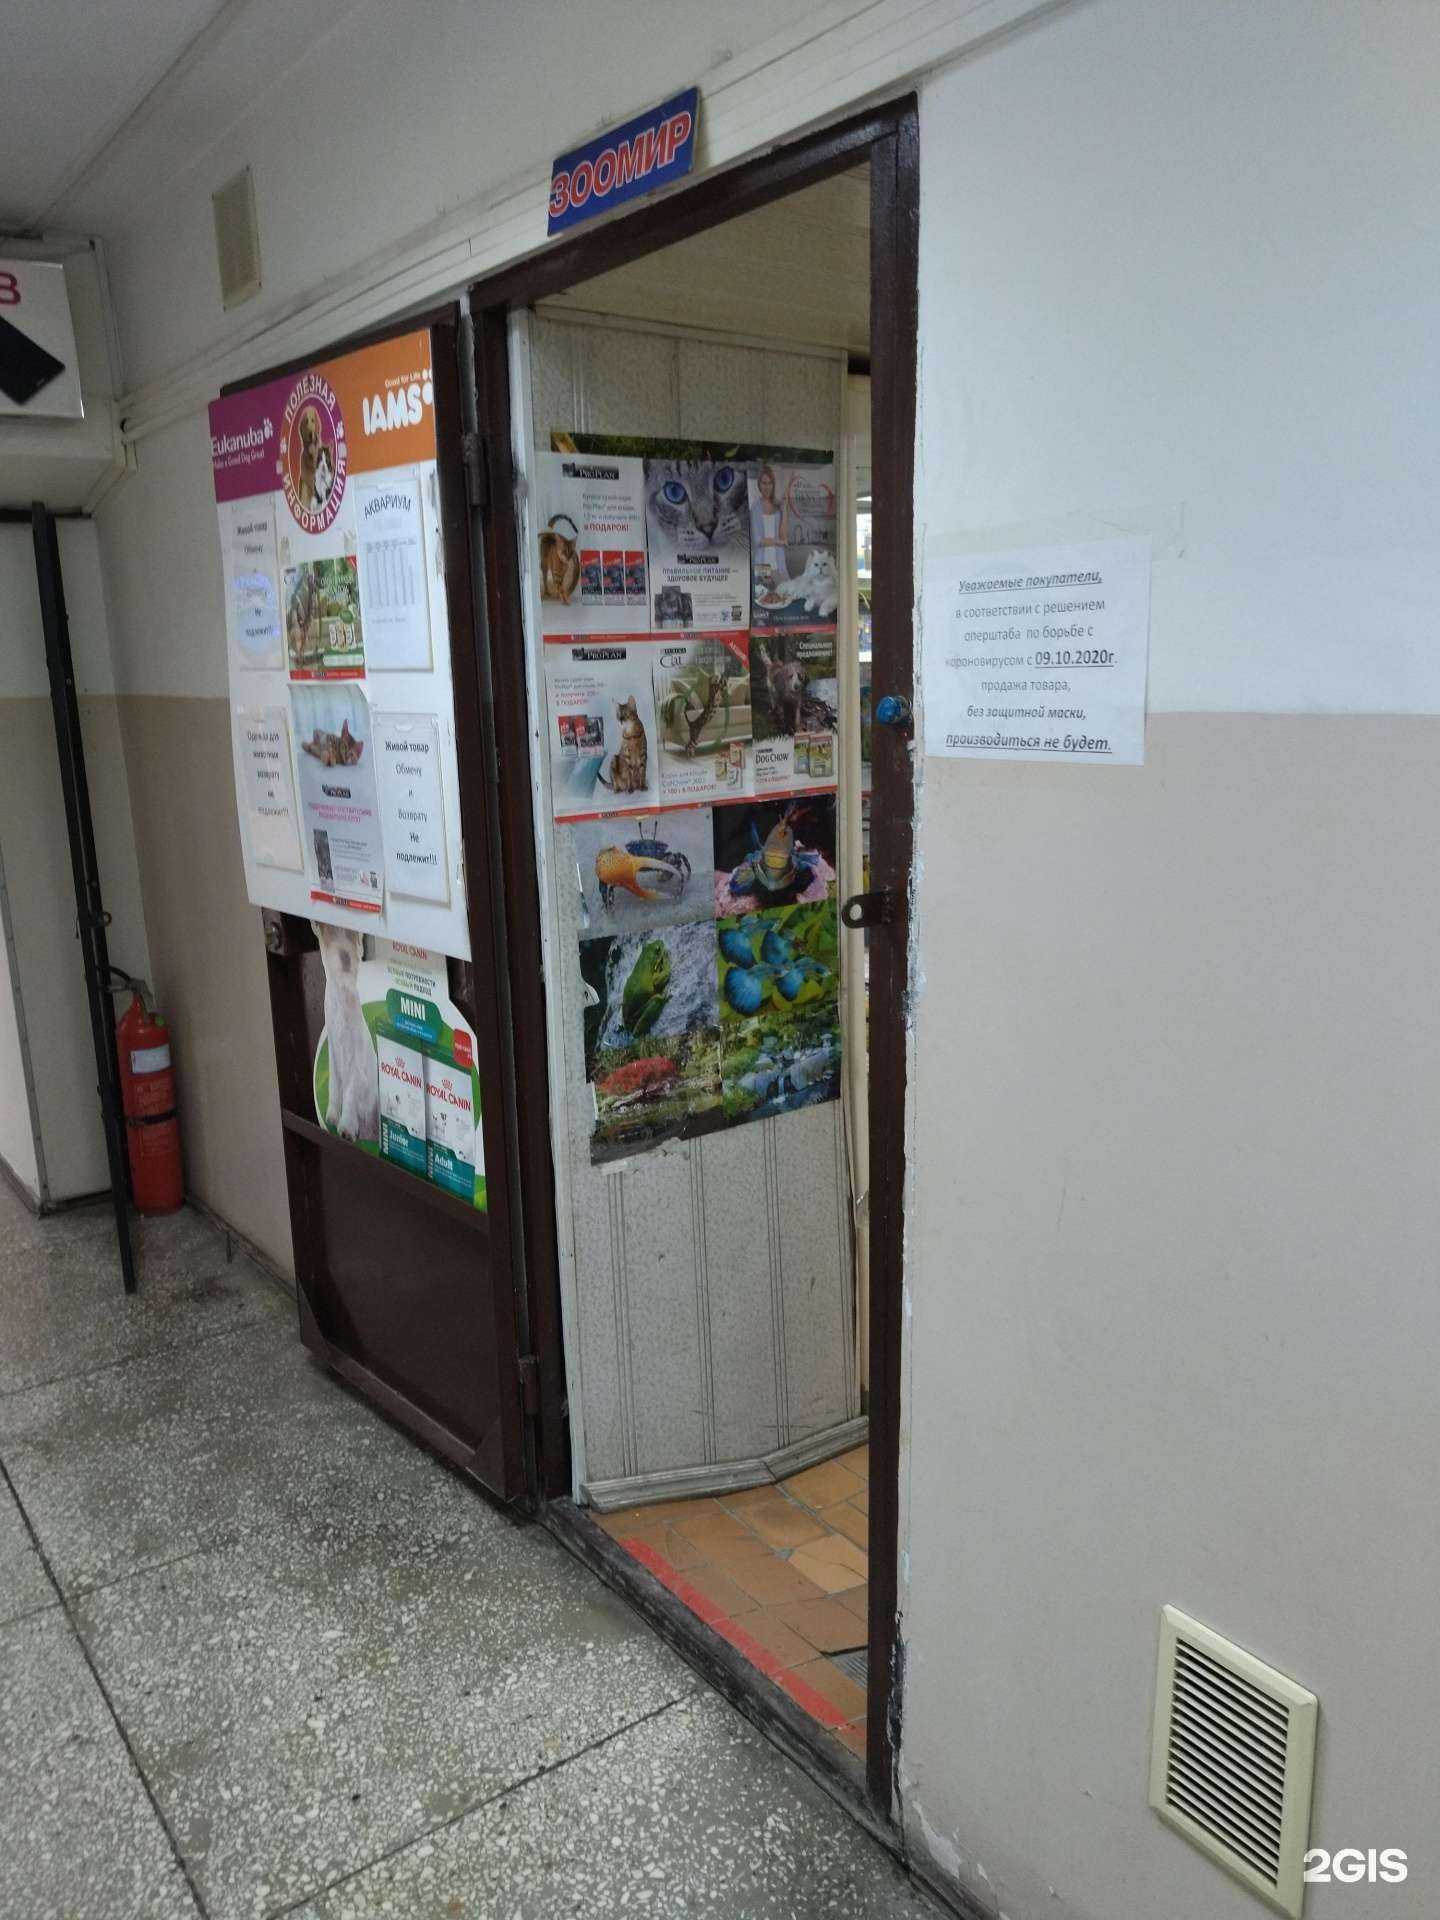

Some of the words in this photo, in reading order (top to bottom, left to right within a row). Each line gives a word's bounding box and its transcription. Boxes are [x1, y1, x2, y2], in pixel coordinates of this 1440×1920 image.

[549, 111, 692, 218] ЗООМИР
[284, 374, 336, 423] ПОЛЕЗНАЯ
[363, 383, 423, 436] IAMS
[212, 427, 264, 457] Eukanuba
[282, 459, 346, 533] ИНФОРМАЦИЯ
[364, 495, 411, 519] АКВАРИУМ
[590, 523, 629, 533] ПОДАРОК!
[958, 577, 1024, 593] Уважаемые
[1025, 570, 1102, 588] покупатели,
[955, 609, 962, 619] в
[964, 604, 1033, 619] соответствии
[1034, 605, 1041, 614] с
[1043, 600, 1105, 616] решением
[964, 627, 1021, 643] оперштаба
[1026, 629, 1040, 639] по
[1042, 624, 1084, 640] борьбе
[1087, 627, 1094, 637] с
[1026, 655, 1033, 666] с
[1035, 649, 1118, 667] 09.10.2020г.
[981, 681, 1028, 694] продажа
[1030, 680, 1071, 693] товара,
[967, 704, 984, 718] без
[987, 705, 1045, 720] защитной
[1049, 708, 1086, 721] маски,
[385, 740, 408, 752] Живой
[409, 742, 429, 754] товар
[946, 733, 1040, 749] производиться
[1043, 737, 1059, 748] не
[1063, 735, 1111, 752] будет.
[755, 753, 769, 764] DOG
[770, 753, 788, 762] CHOW
[410, 831, 419, 843] Не
[392, 941, 409, 955] ROYAL
[400, 996, 426, 1021] MINI
[381, 1062, 401, 1080] ROYAL
[401, 1071, 422, 1089] CANIN
[426, 1083, 447, 1101] ROYAL
[448, 1093, 471, 1112] CANIN
[434, 1154, 453, 1171] Adult
